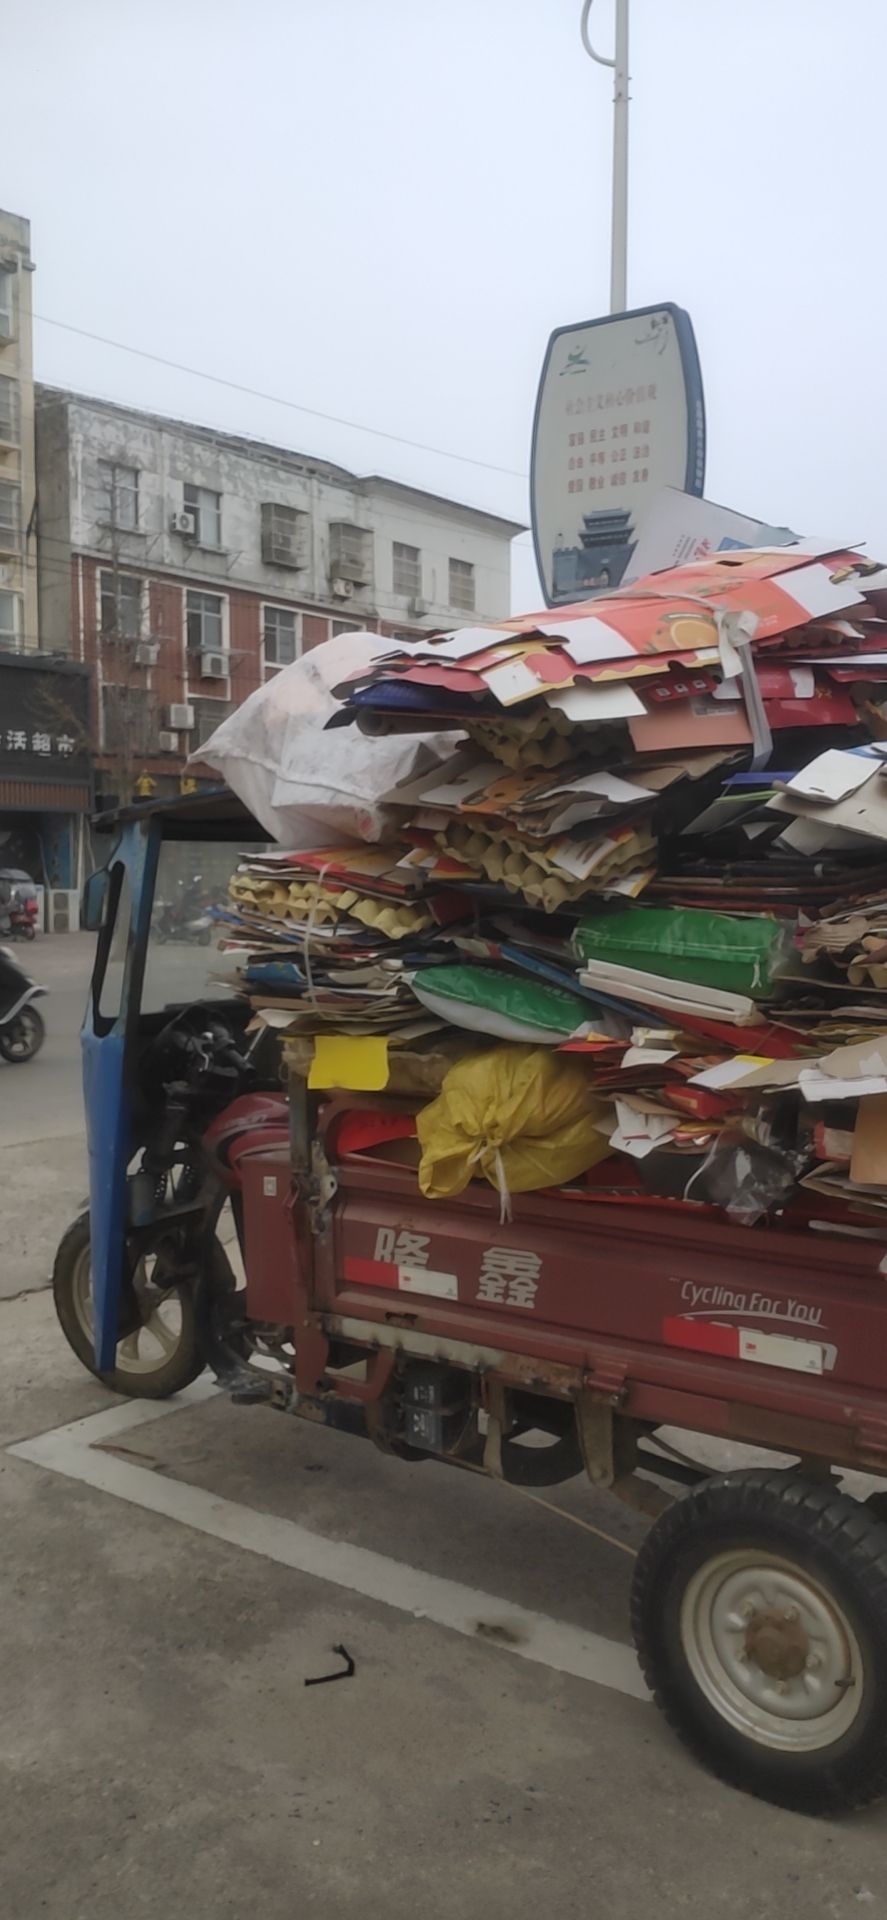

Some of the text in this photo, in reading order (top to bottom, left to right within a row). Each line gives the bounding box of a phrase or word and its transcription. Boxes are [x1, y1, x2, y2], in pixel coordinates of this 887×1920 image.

[0, 730, 75, 758] 活超市
[681, 1280, 823, 1324] Cycling For You
